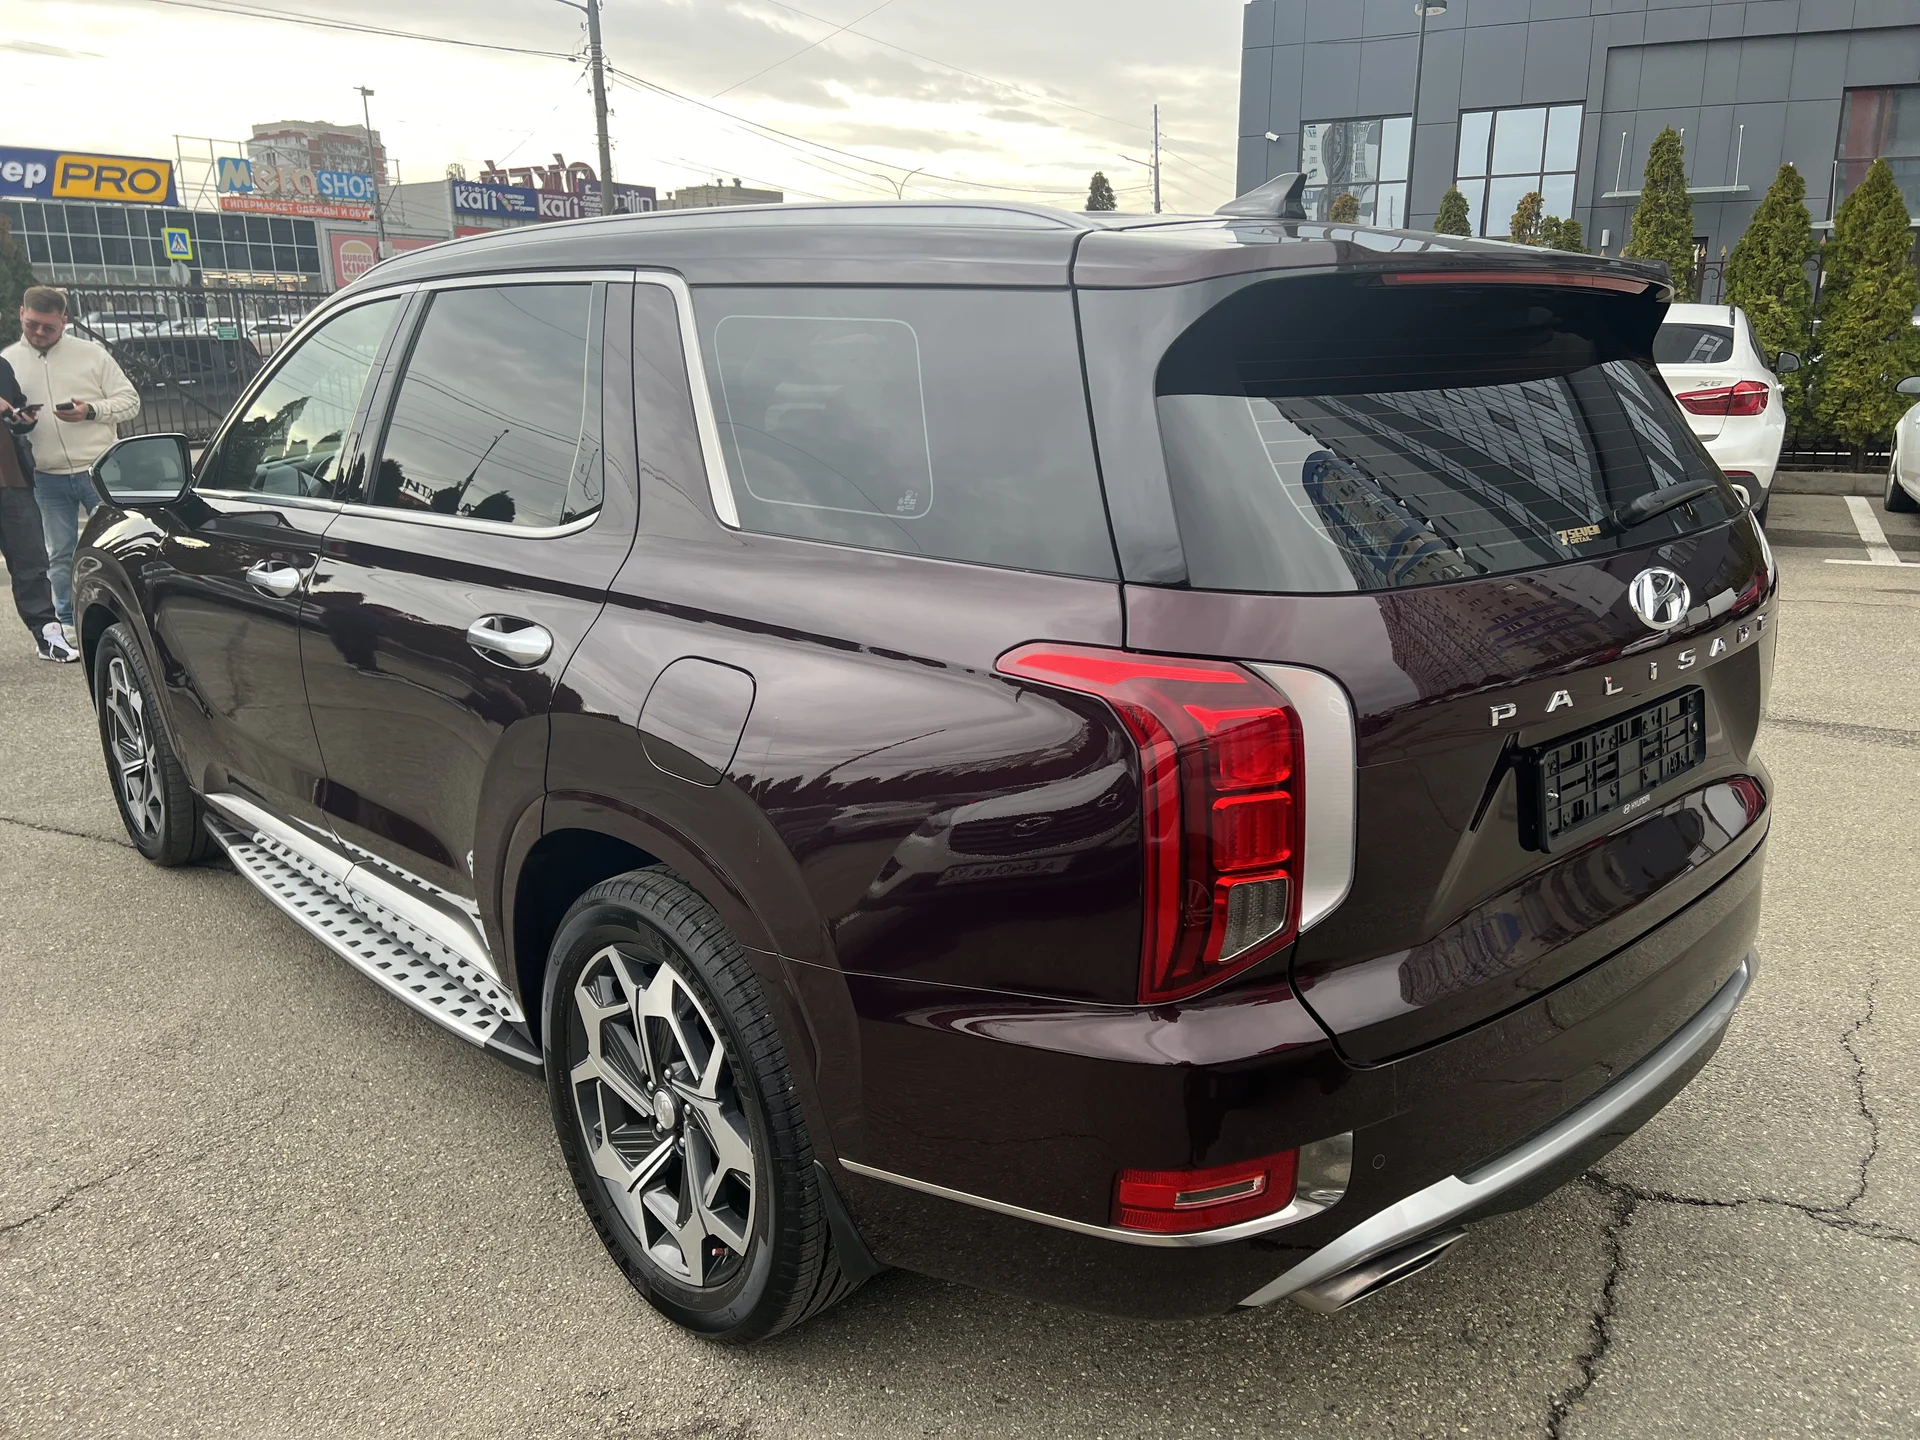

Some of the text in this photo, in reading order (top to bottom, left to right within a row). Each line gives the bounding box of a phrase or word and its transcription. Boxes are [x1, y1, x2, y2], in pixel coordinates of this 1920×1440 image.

[0, 161, 161, 194] ер PRO
[455, 186, 497, 210] kari
[538, 193, 579, 218] kari
[225, 200, 293, 212] ГИПЕРМАРКЕТ
[296, 204, 338, 216] ОДЕЖДЫ
[341, 208, 347, 216] И
[342, 254, 373, 263] BURGER
[1696, 379, 1723, 388] X6
[1570, 536, 1593, 545] DETAIL
